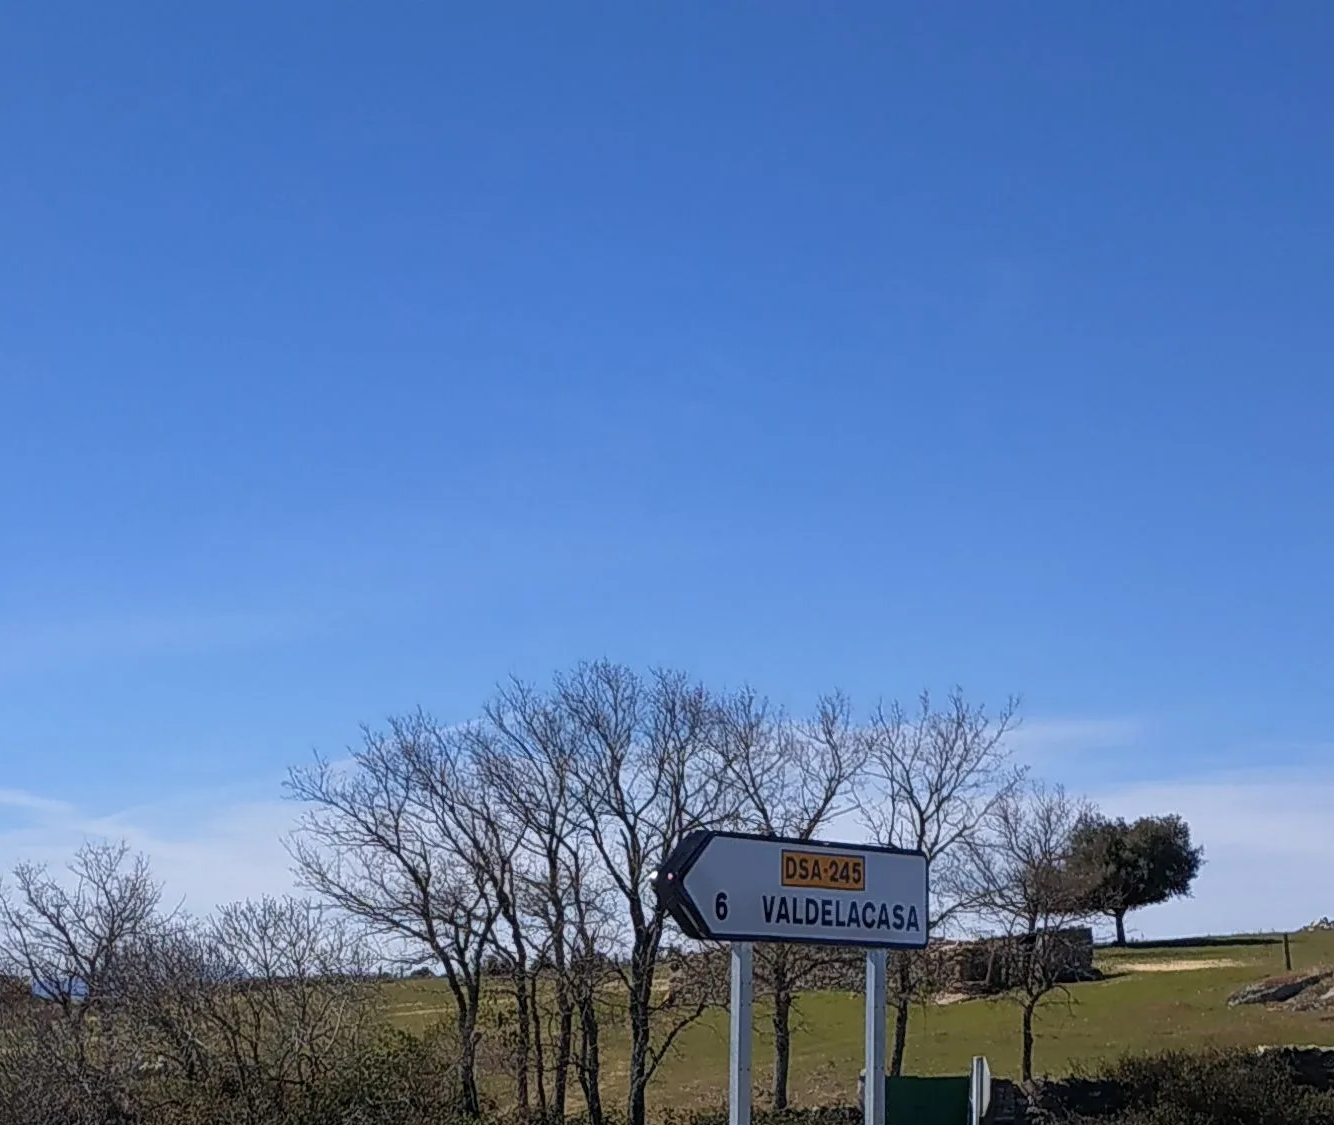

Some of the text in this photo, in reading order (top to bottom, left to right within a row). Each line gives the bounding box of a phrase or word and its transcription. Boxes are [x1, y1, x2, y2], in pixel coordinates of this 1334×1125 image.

[785, 857, 862, 884] DSA-245
[715, 892, 920, 931] 6 VALDELACASA
